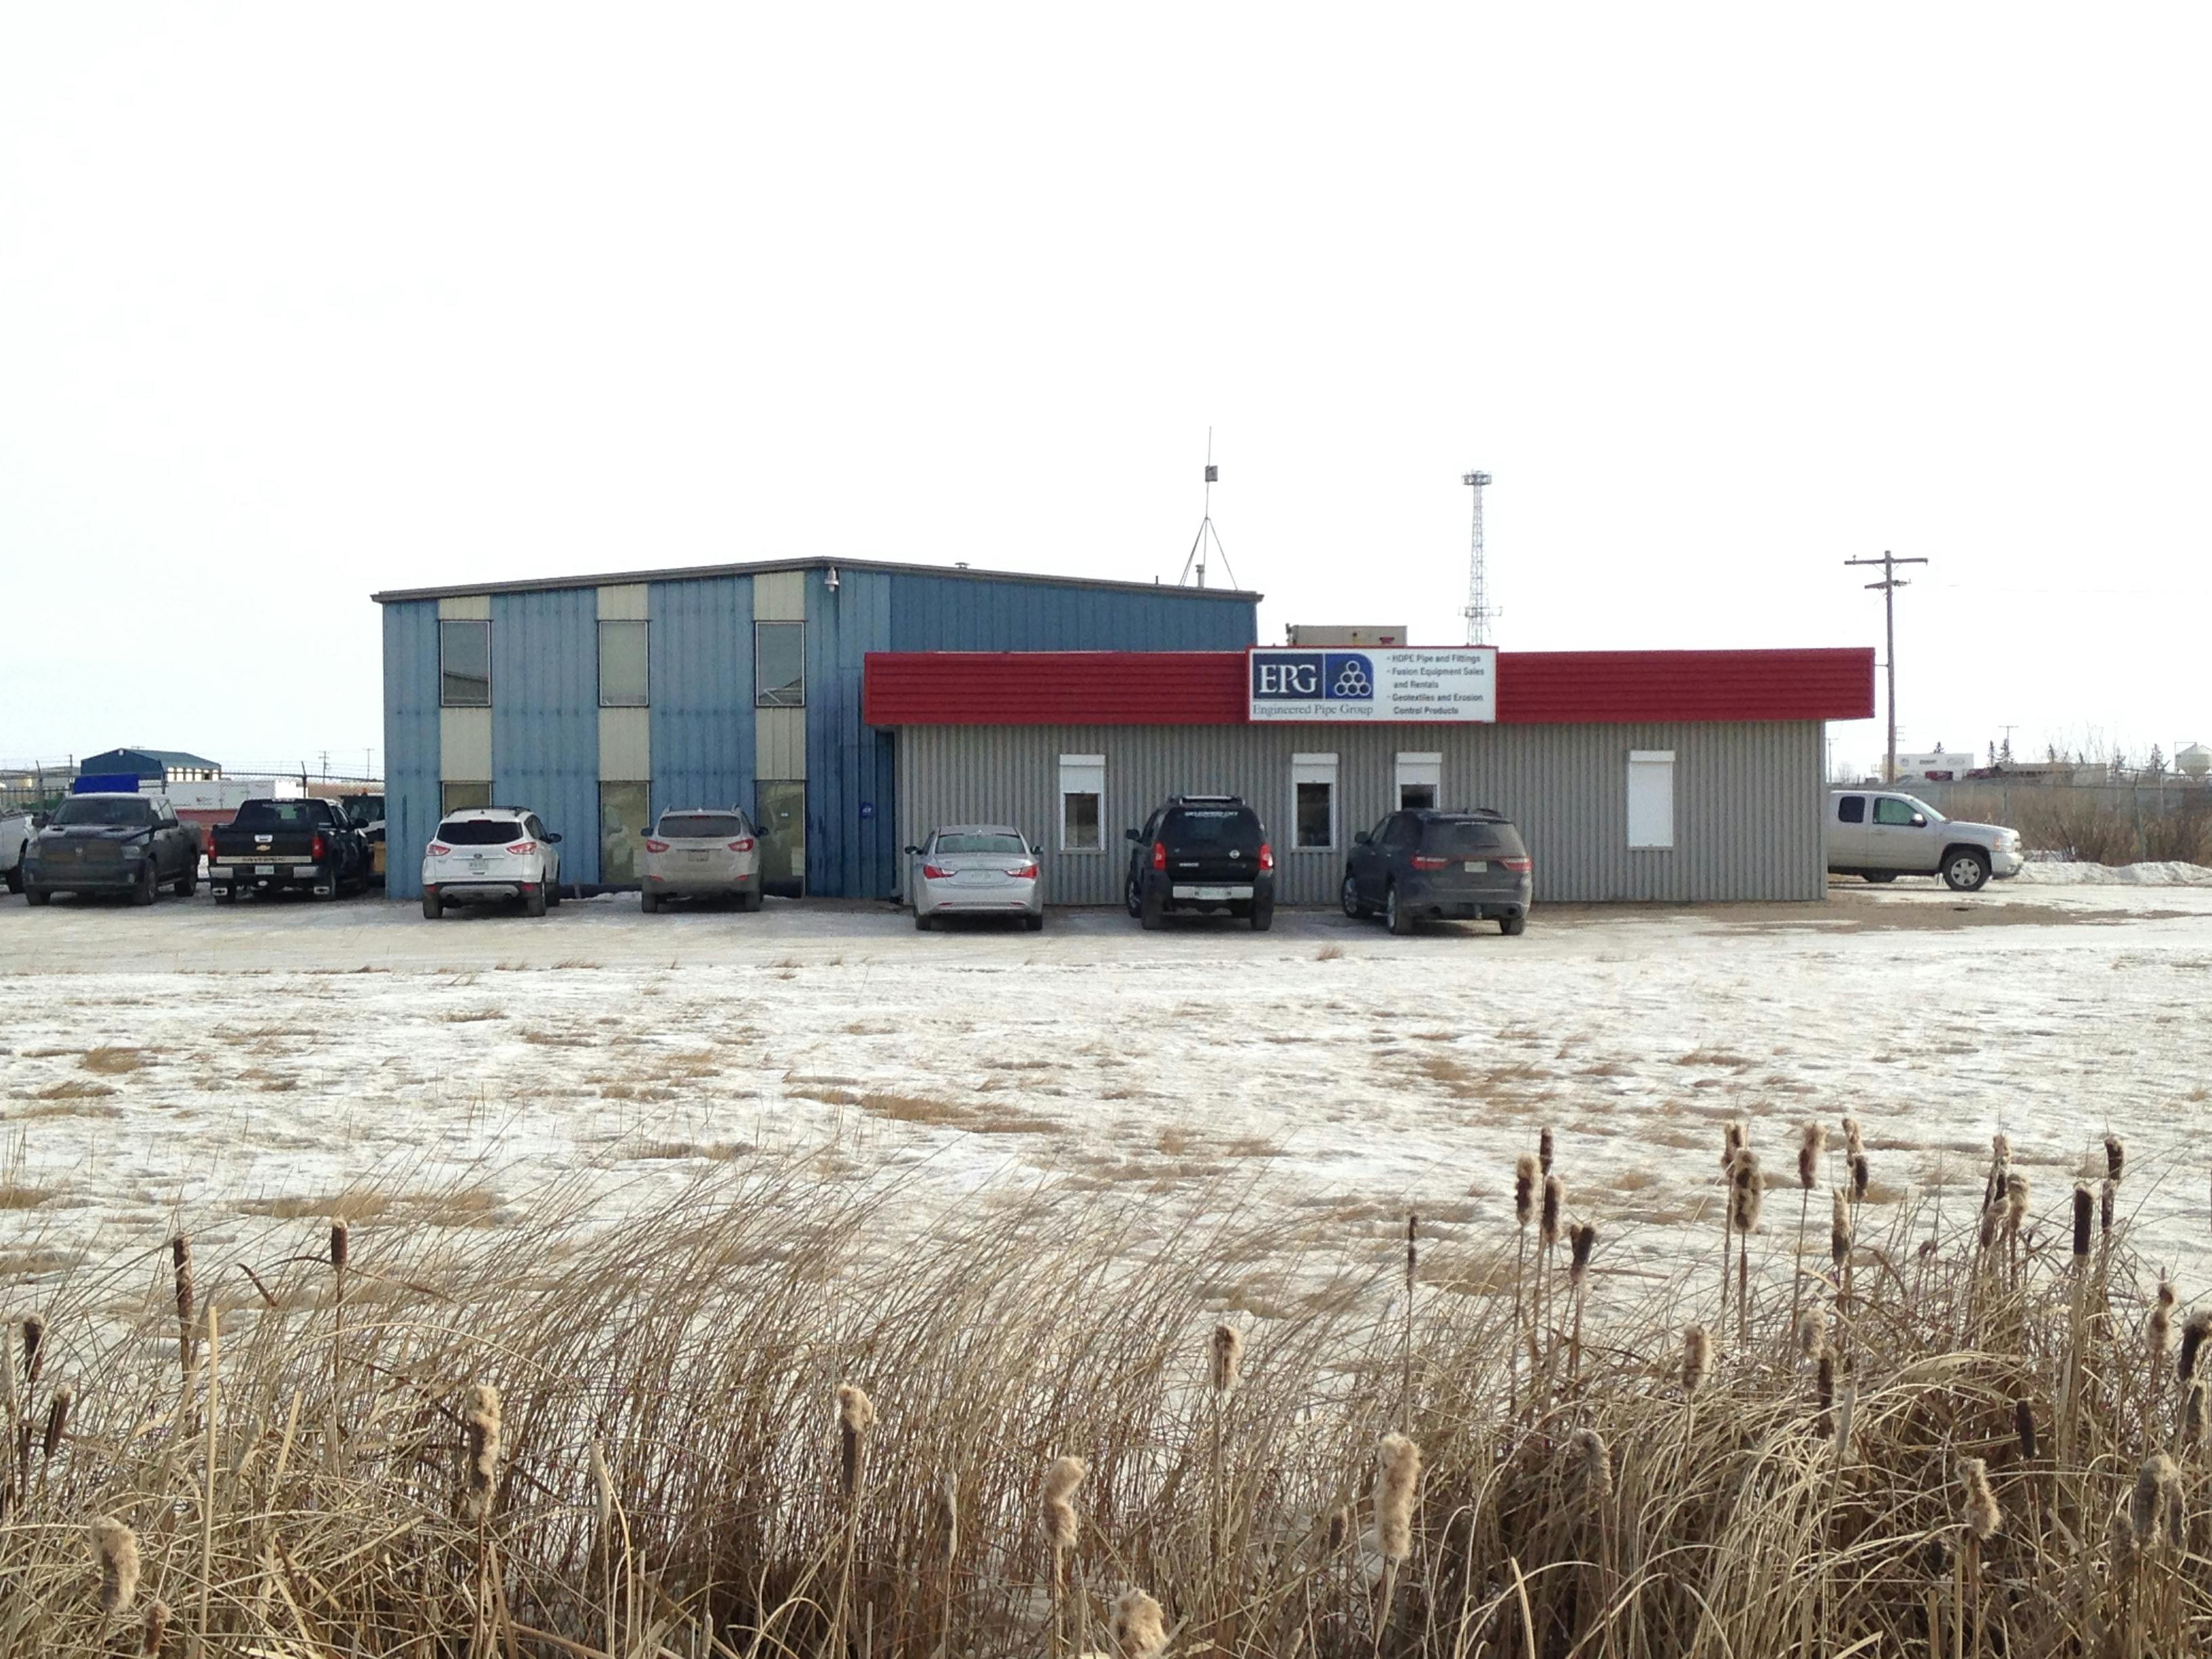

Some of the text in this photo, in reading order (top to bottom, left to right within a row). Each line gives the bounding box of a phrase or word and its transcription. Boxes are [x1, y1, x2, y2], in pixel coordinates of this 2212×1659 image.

[1416, 654, 1433, 663] Pipe
[1435, 654, 1450, 663] and
[1452, 654, 1481, 664] Fittings
[1392, 667, 1485, 677] Fusion Equipment Sales
[1258, 664, 1317, 693] EPG
[1393, 680, 1439, 689] and Rentals
[1392, 693, 1483, 702] Geotextiles and Erosion
[1253, 704, 1374, 716] Engineered Pipe Group
[1393, 706, 1459, 715] Control Products
